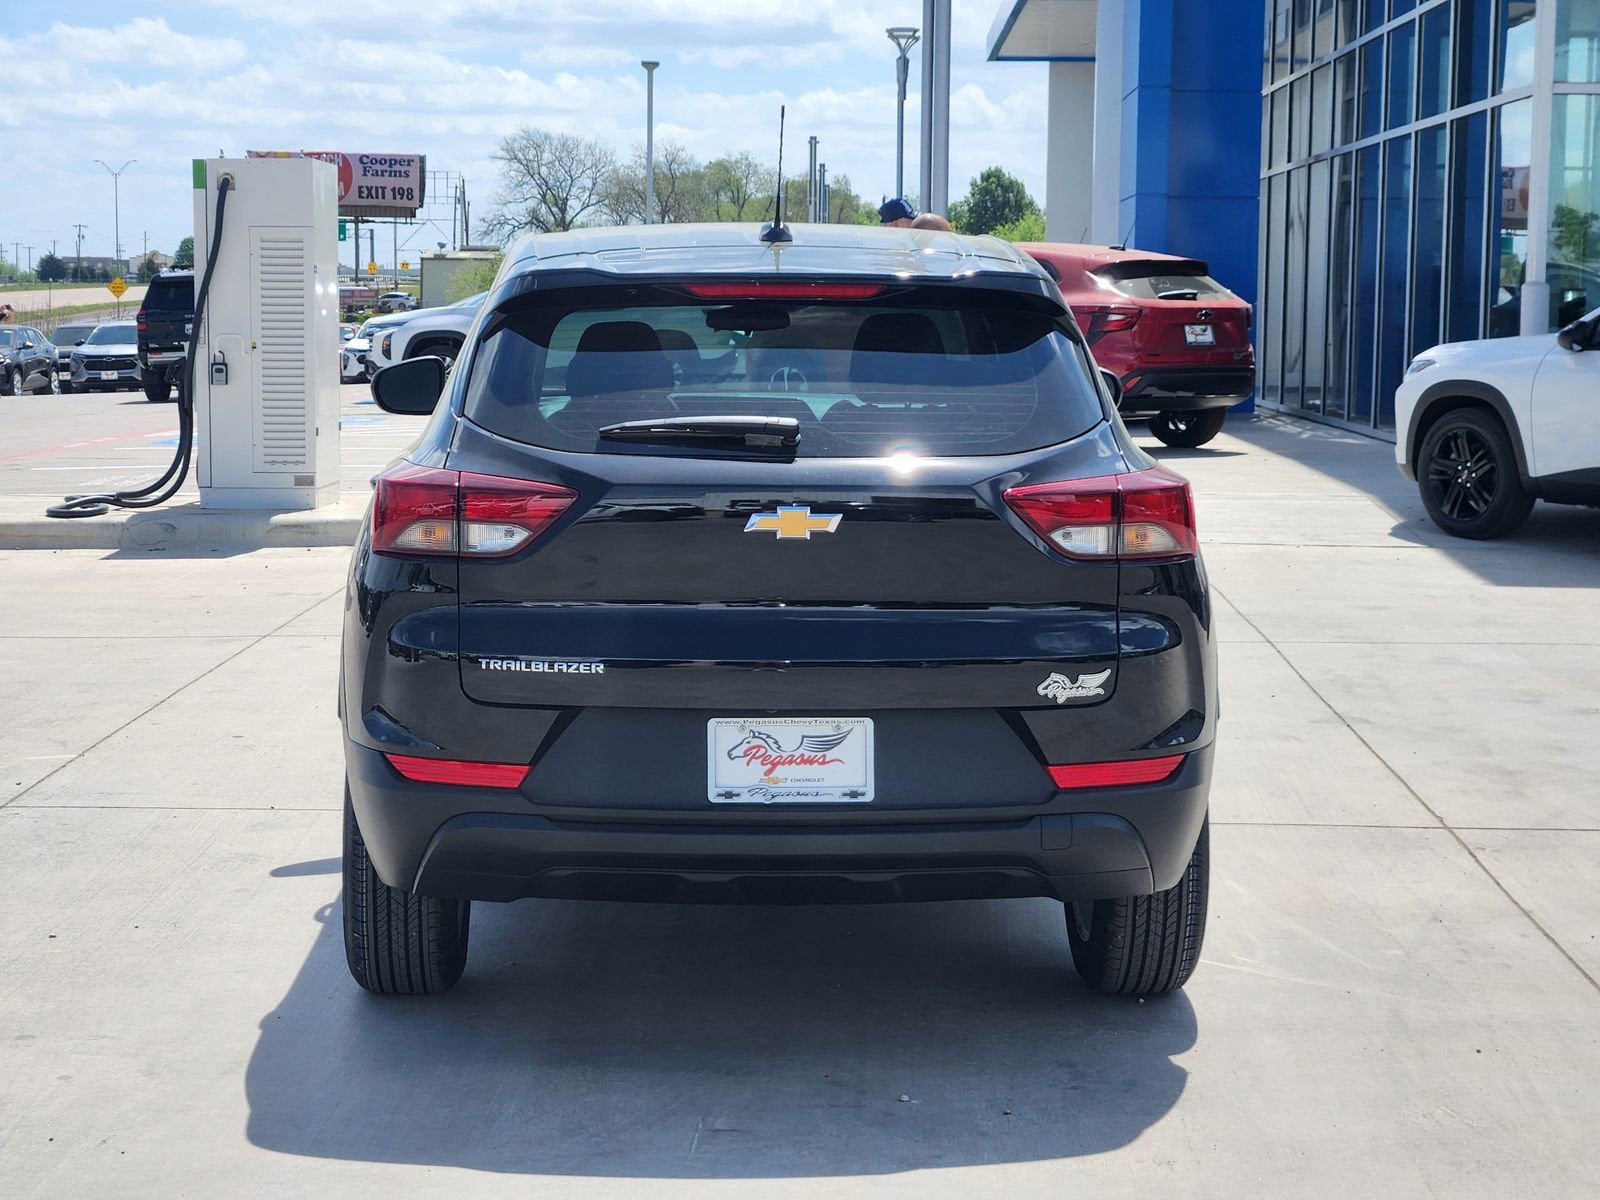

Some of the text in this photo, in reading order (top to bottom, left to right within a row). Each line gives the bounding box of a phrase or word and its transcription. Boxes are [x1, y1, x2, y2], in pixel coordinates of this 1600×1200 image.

[358, 154, 414, 168] Cooper
[361, 165, 410, 178] Farms
[358, 186, 387, 200] EXIT
[390, 186, 414, 201] 198
[479, 658, 604, 673] TRAILBLAZER
[743, 744, 845, 776] Pegasus
[747, 787, 834, 802] Pegasus
